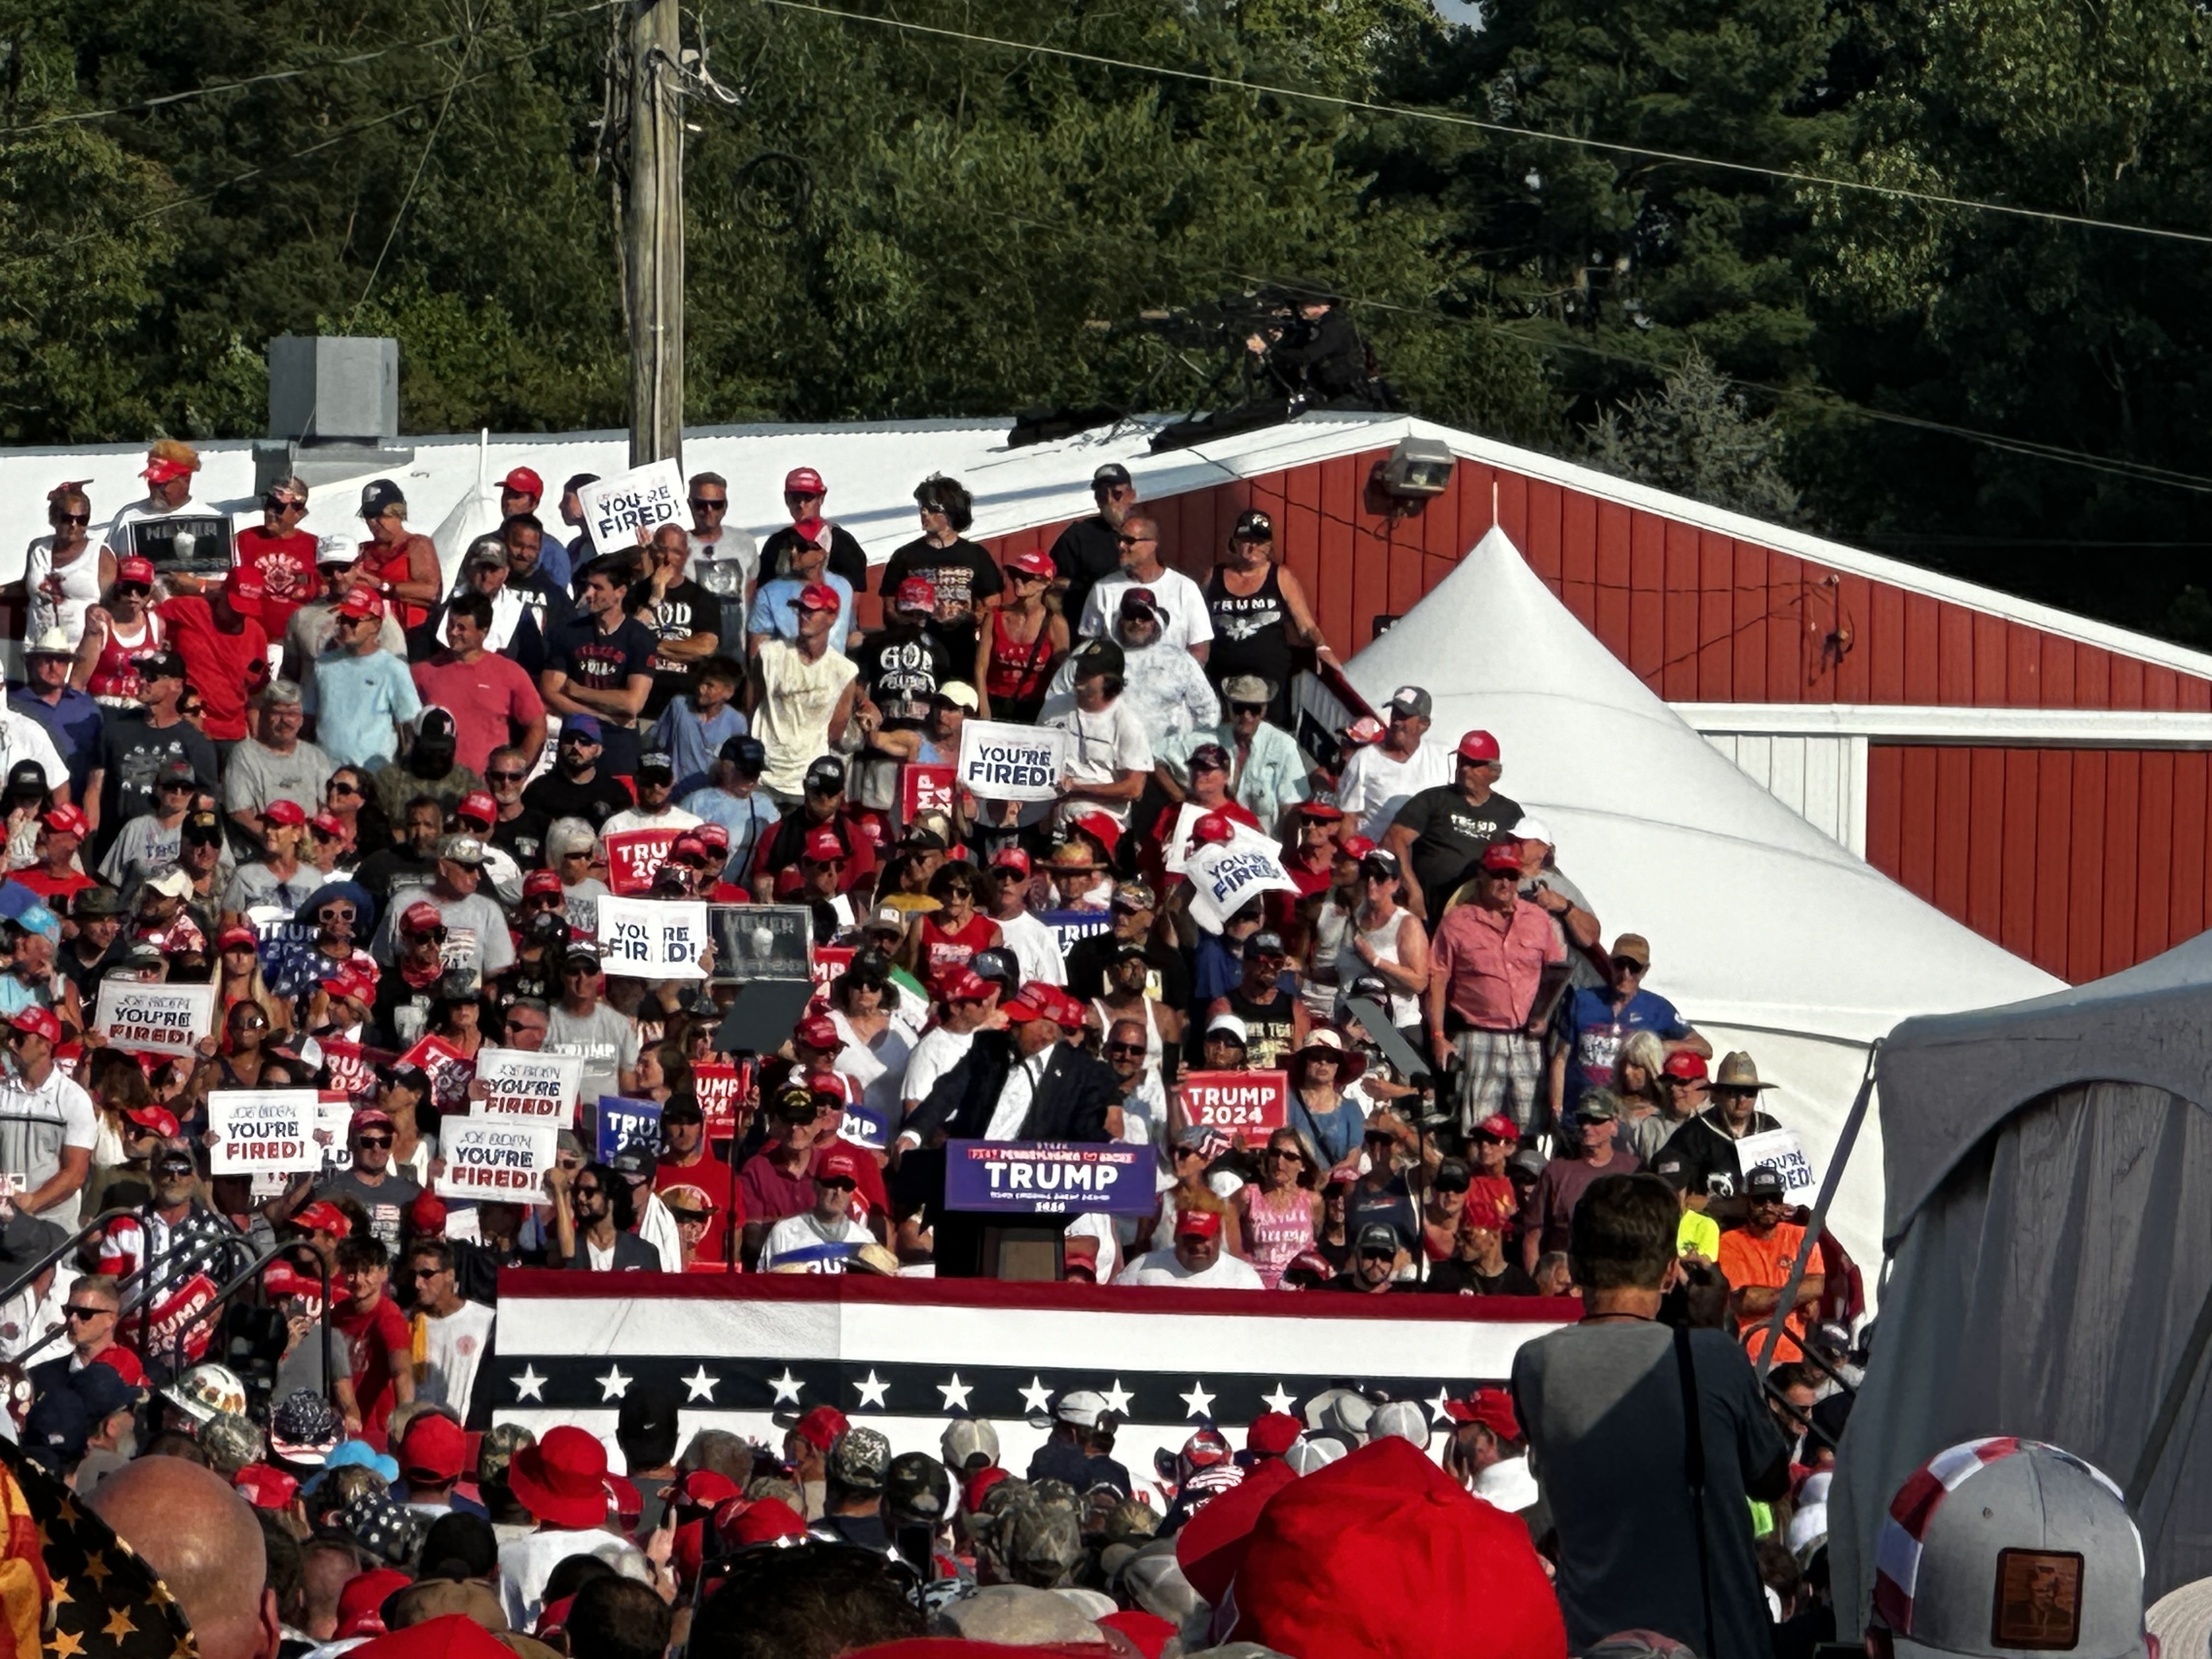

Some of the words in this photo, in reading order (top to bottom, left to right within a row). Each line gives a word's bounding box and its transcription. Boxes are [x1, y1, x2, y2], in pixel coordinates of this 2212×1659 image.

[598, 499, 681, 539] FIRED!
[979, 743, 1052, 766] YOU'RE
[969, 761, 1055, 787] FIRED!
[617, 842, 672, 863] TRU
[610, 938, 695, 963] FIRD!
[484, 1097, 562, 1117] FIRED!
[1188, 1087, 1276, 1106] TRUMP
[607, 1111, 662, 1138] TRU
[1201, 1106, 1263, 1124] 2024
[228, 1121, 299, 1139] YOU'RE
[227, 1141, 305, 1160] FIRED!
[456, 1146, 533, 1168] YOU'RE
[452, 1167, 537, 1190] FIRED!
[984, 1161, 1119, 1190] TRUMP
